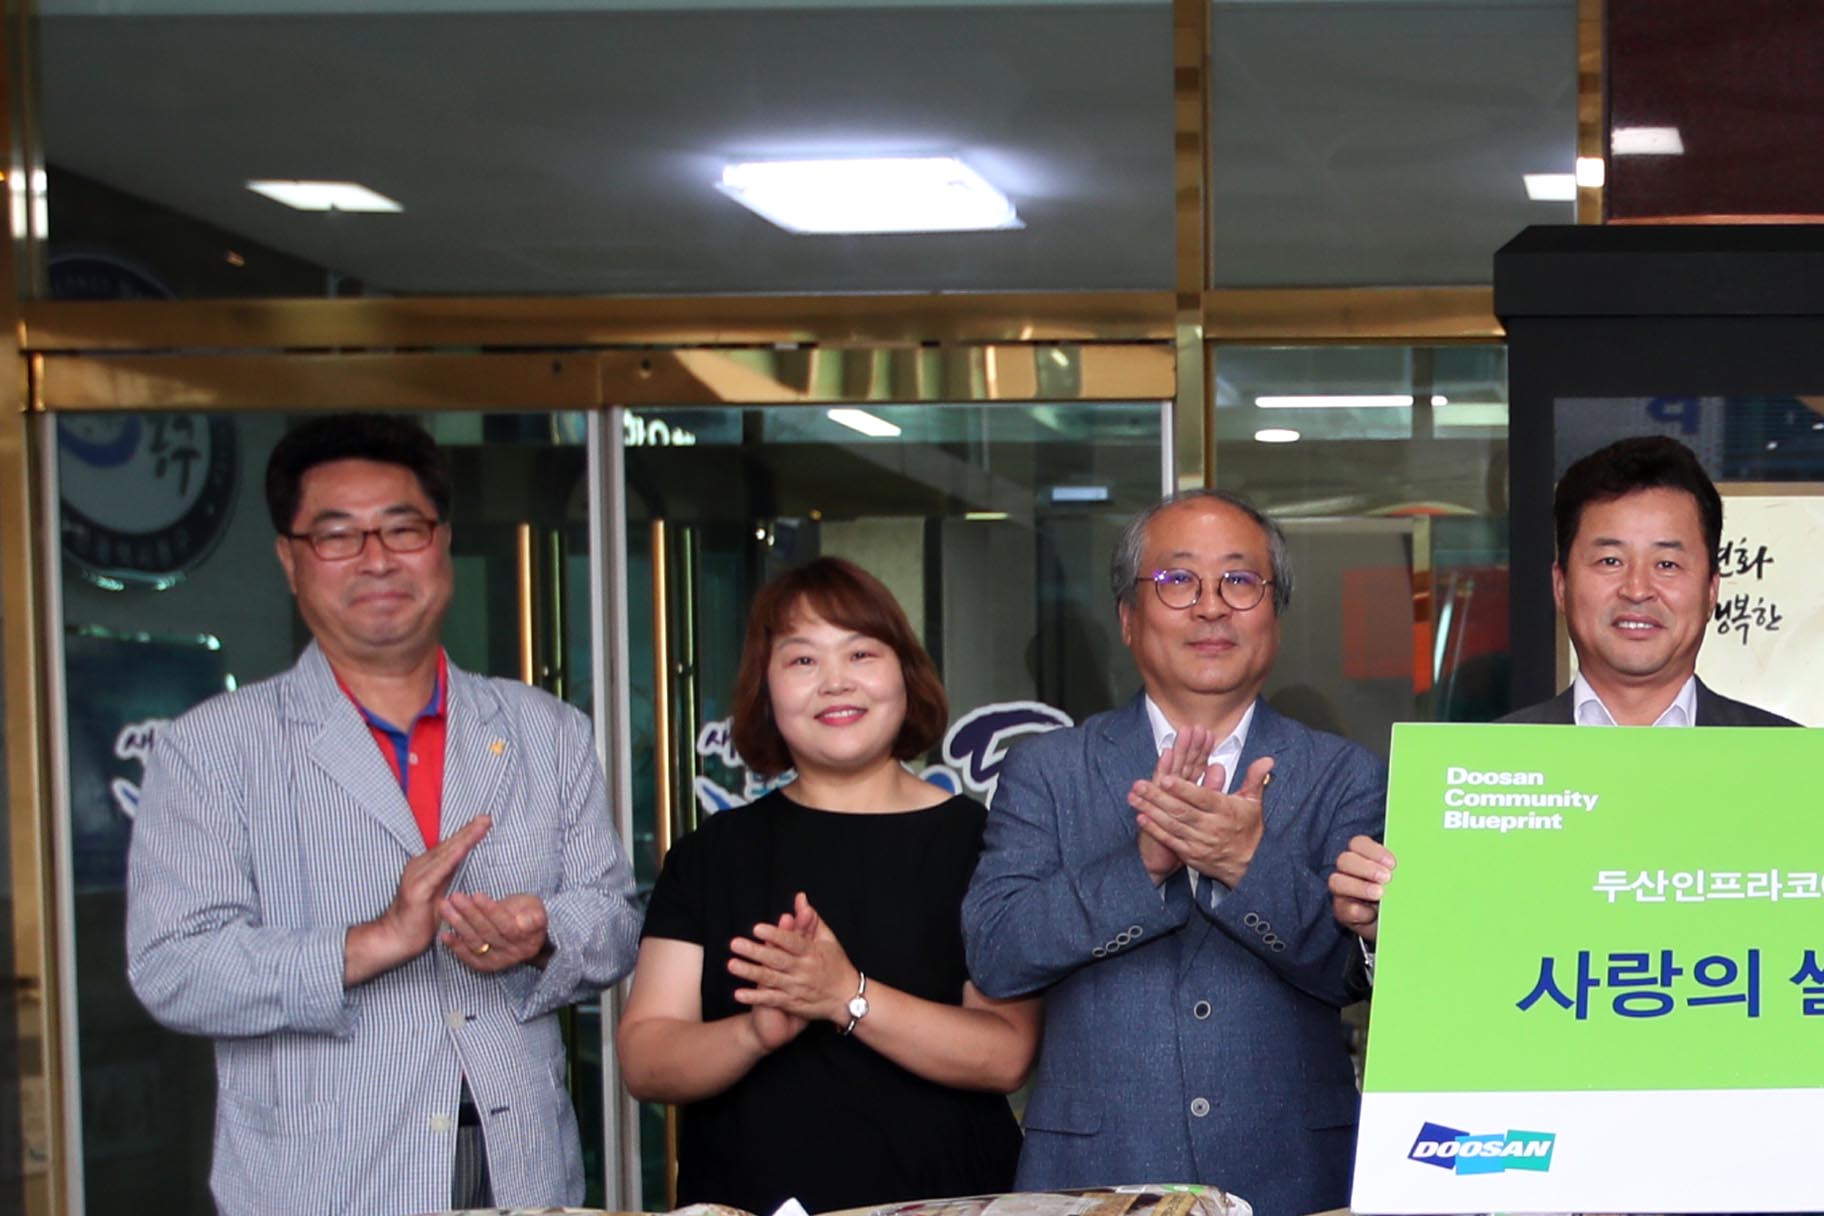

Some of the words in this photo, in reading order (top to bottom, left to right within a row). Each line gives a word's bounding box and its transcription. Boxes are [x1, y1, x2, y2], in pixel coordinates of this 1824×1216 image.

[1446, 767, 1544, 785] Doosan
[1444, 789, 1599, 811] Community
[1443, 811, 1562, 833] Blueprint
[1515, 948, 1762, 1021] 사랑의
[1411, 1140, 1553, 1159] DOOSAN
